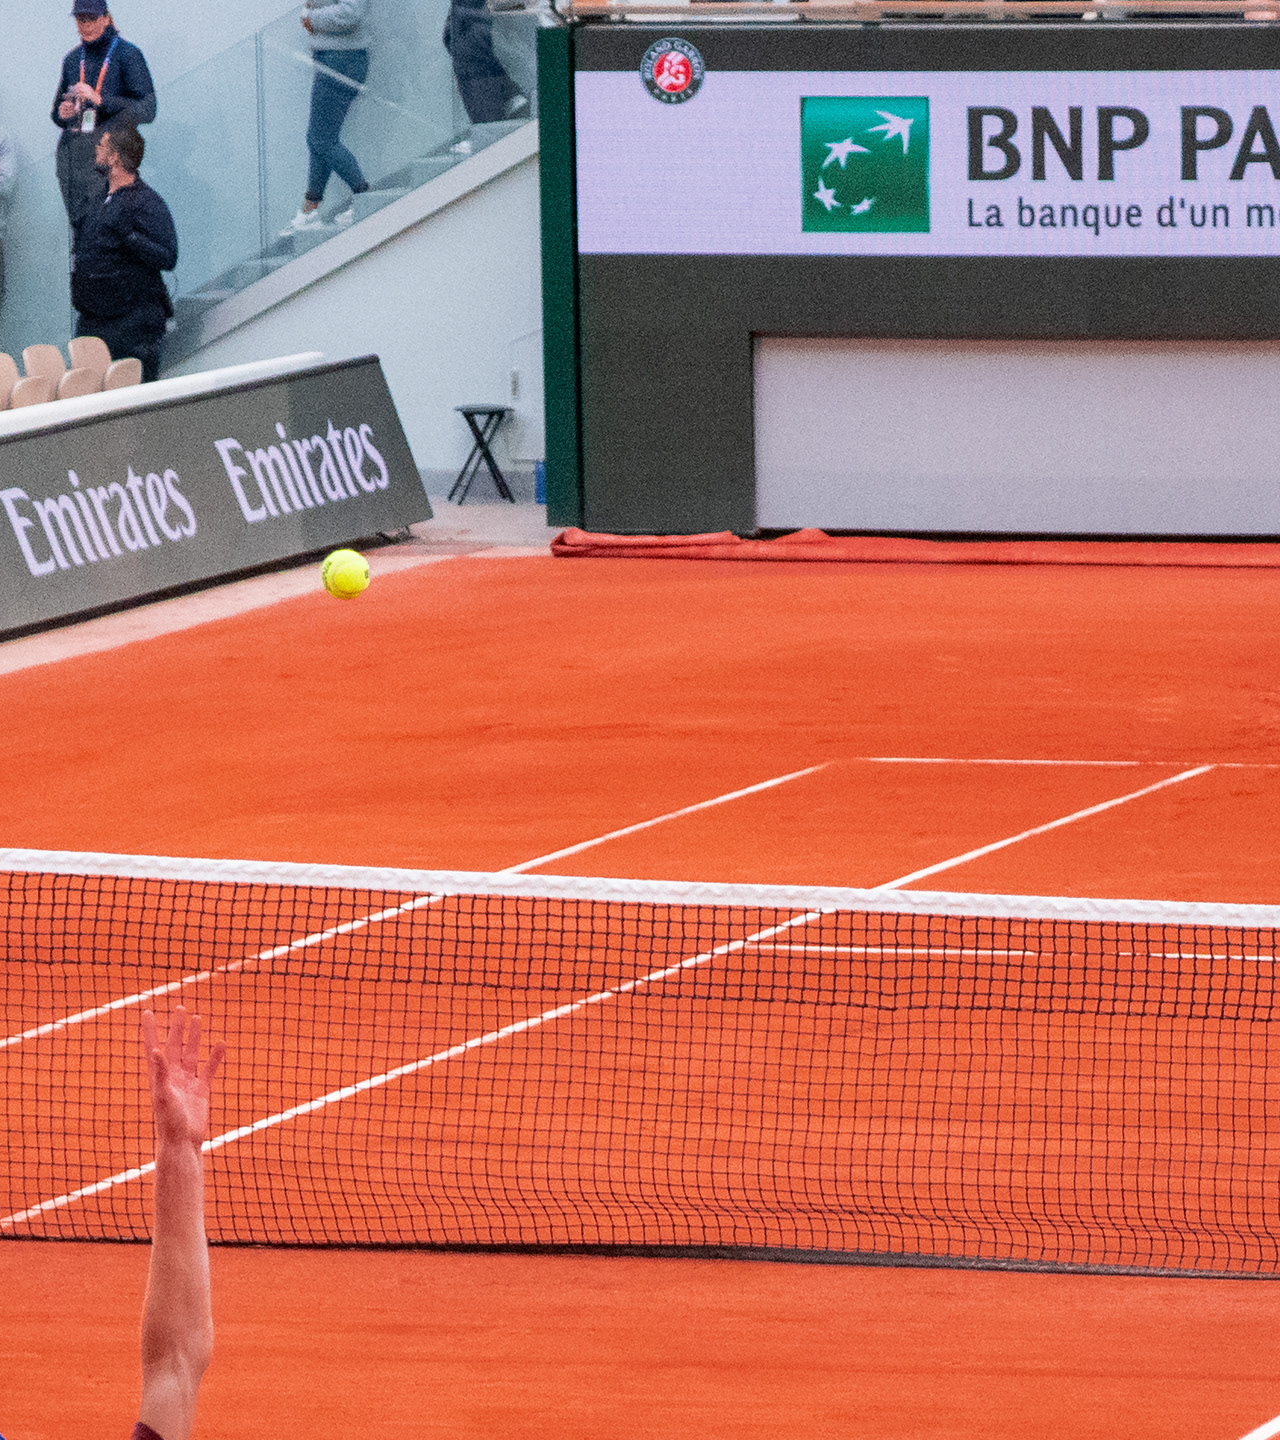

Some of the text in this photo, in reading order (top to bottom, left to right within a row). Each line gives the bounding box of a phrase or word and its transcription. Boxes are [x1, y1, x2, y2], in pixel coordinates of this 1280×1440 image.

[968, 107, 1149, 180] BNP
[968, 198, 1004, 227] La
[1018, 197, 1142, 236] banque
[1157, 196, 1229, 228] d'un
[214, 422, 388, 523] Emirates
